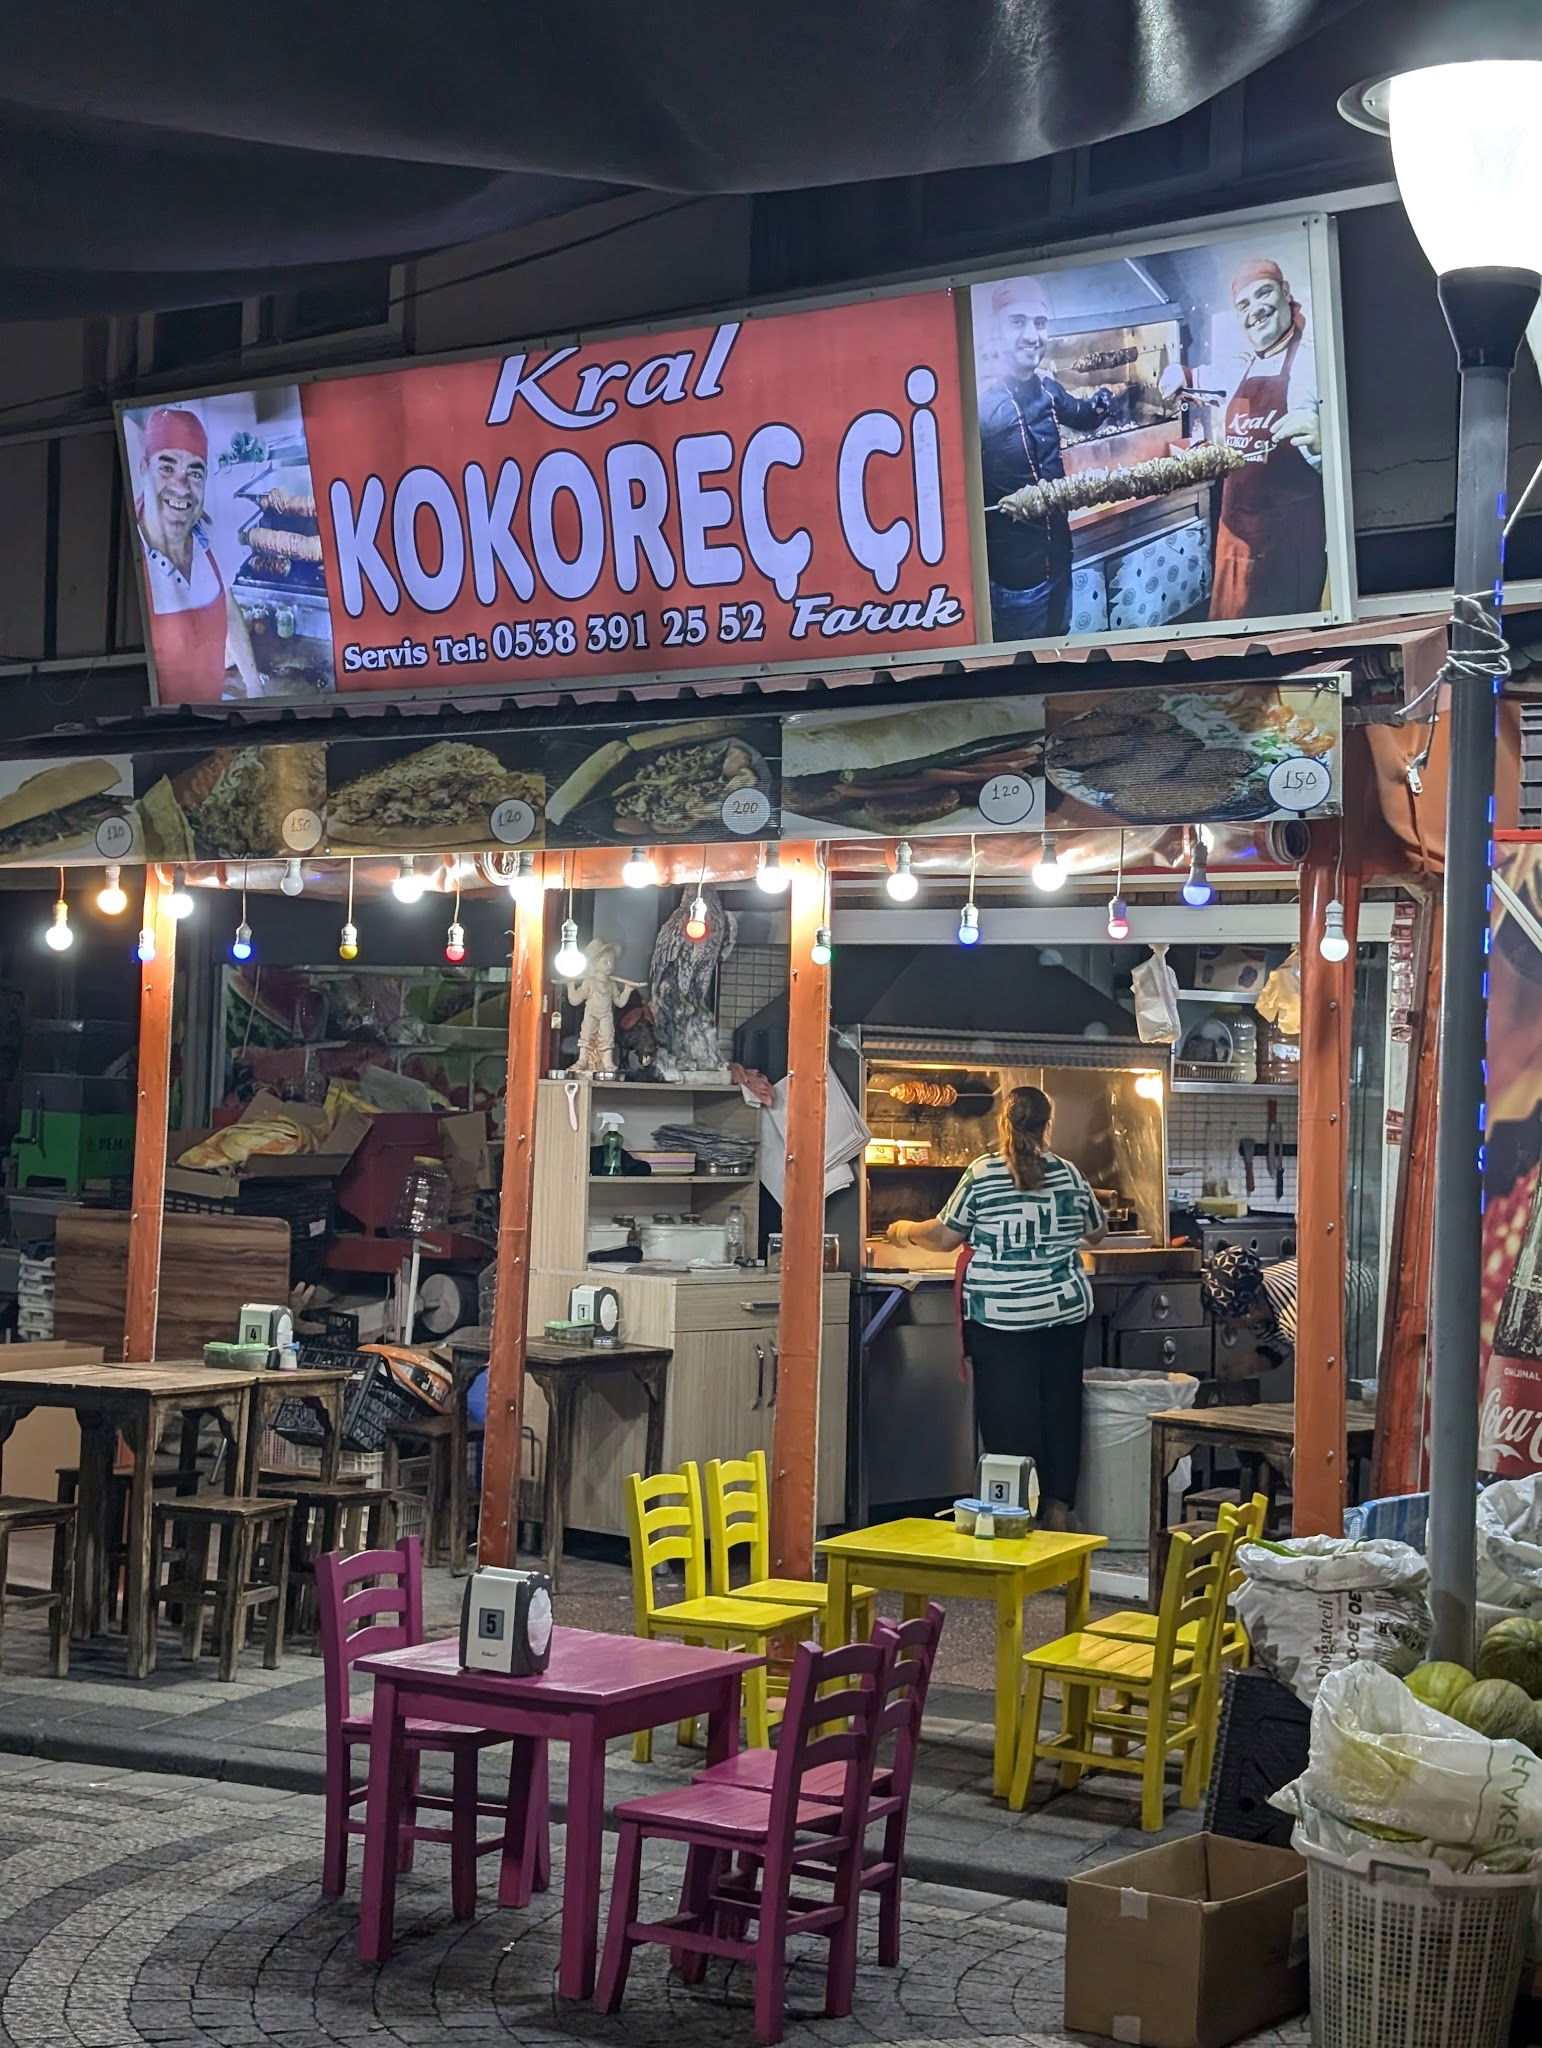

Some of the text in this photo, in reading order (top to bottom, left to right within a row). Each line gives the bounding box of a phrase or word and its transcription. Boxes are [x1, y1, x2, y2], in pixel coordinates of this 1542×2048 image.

[486, 323, 741, 431] Kral
[329, 421, 814, 620] KOKOREÇ
[788, 583, 966, 643] Faruk
[344, 600, 766, 671] Servis Tel: 0538 391 25 52
[1282, 770, 1317, 790] 150
[992, 783, 1020, 801] 120
[732, 799, 759, 815] 200
[498, 810, 521, 827] 120
[580, 1306, 586, 1318] 1
[249, 1328, 258, 1341] 4
[994, 1484, 1004, 1499] 3
[486, 1613, 497, 1634] 5
